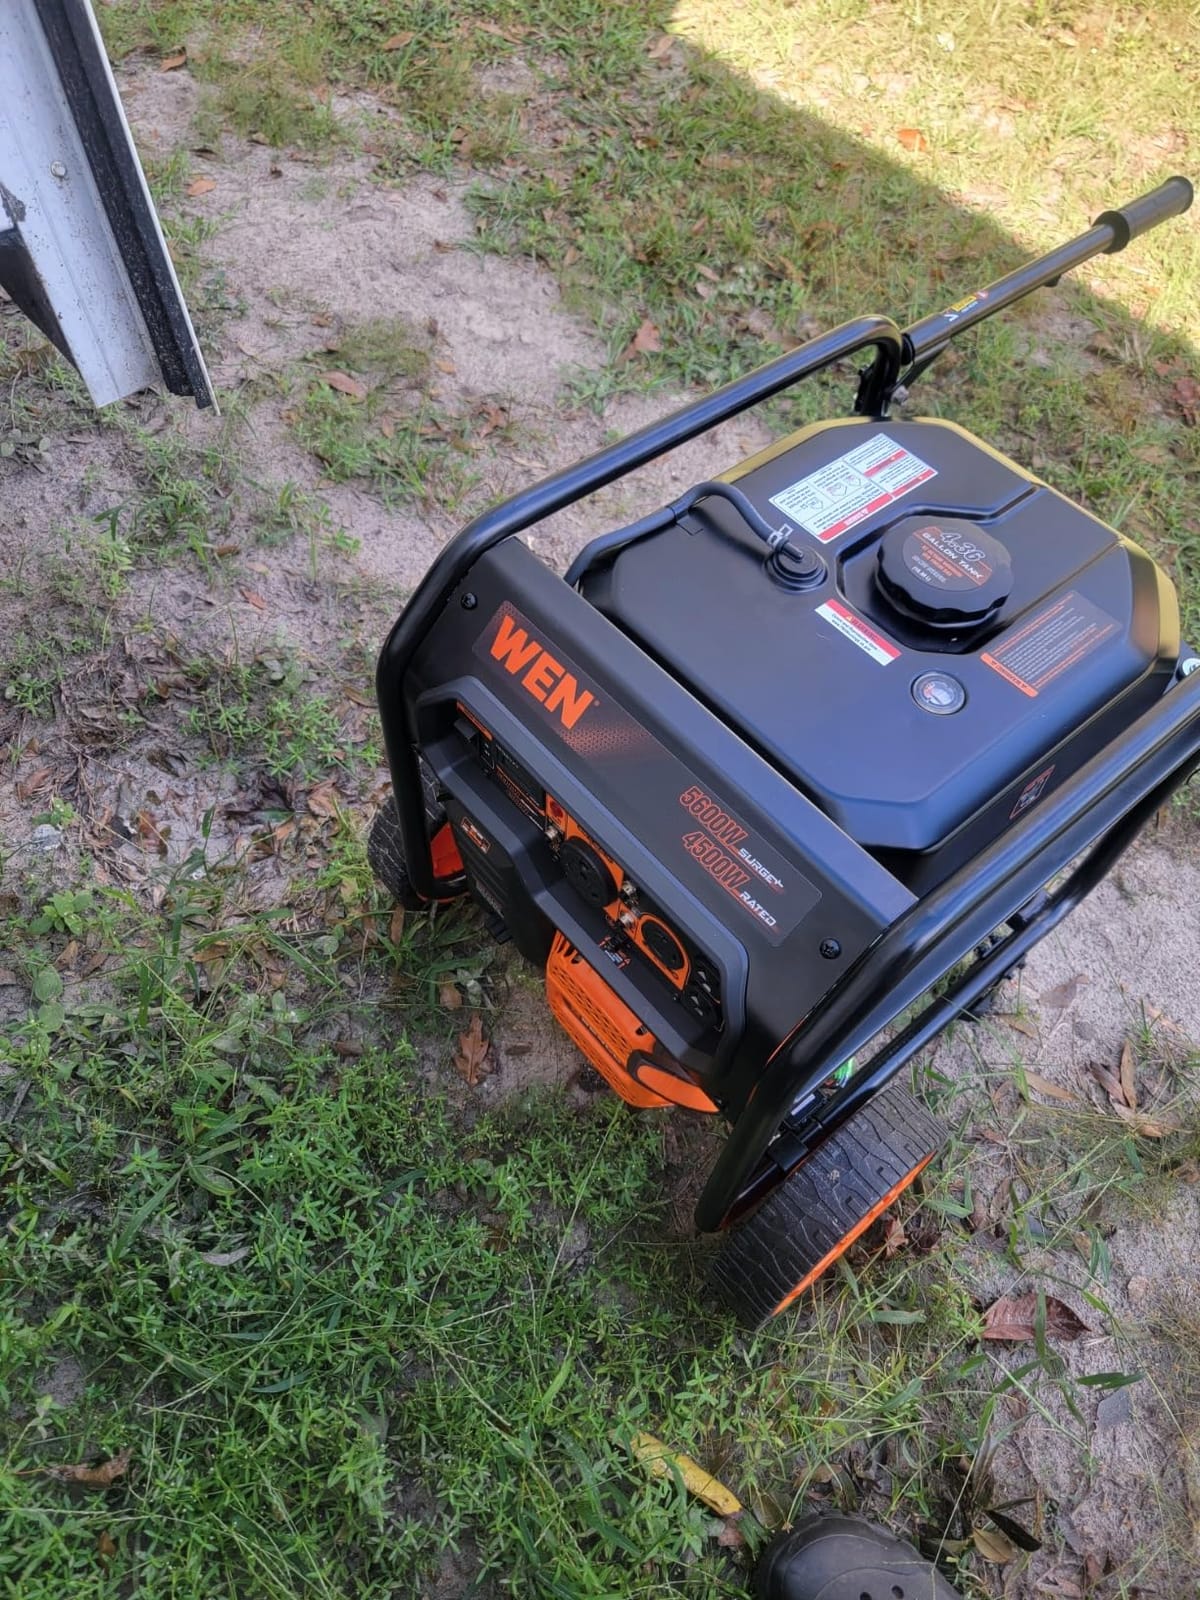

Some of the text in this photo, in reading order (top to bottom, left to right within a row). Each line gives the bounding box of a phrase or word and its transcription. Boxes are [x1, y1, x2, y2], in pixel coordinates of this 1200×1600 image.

[922, 532, 958, 560] GALLON
[958, 560, 984, 579] TANK
[490, 615, 595, 730] WEN
[679, 785, 749, 847] 5600W
[682, 831, 777, 927] 4500W RATED
